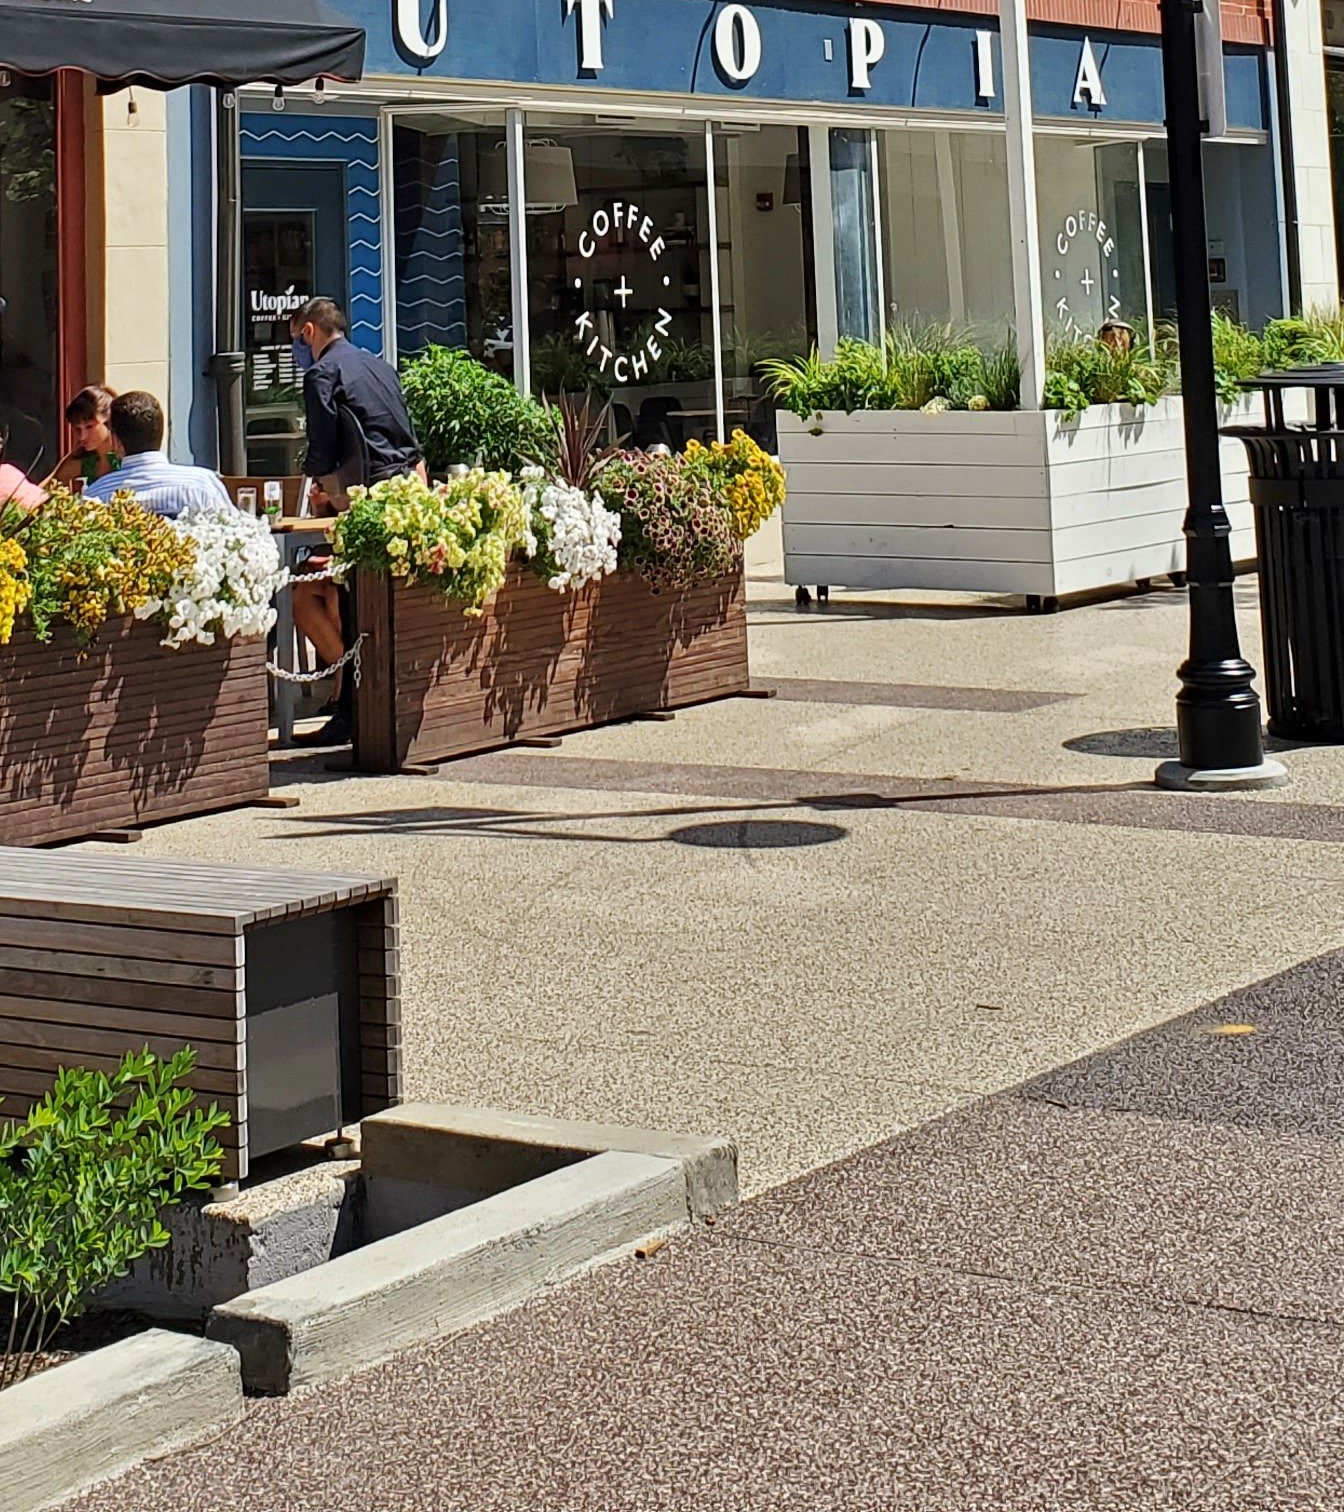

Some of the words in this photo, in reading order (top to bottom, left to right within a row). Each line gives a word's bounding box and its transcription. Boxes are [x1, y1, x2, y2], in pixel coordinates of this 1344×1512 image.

[579, 202, 665, 261] COFFEE
[1057, 210, 1115, 258] COFFEE
[575, 308, 672, 383] KITCHEN
